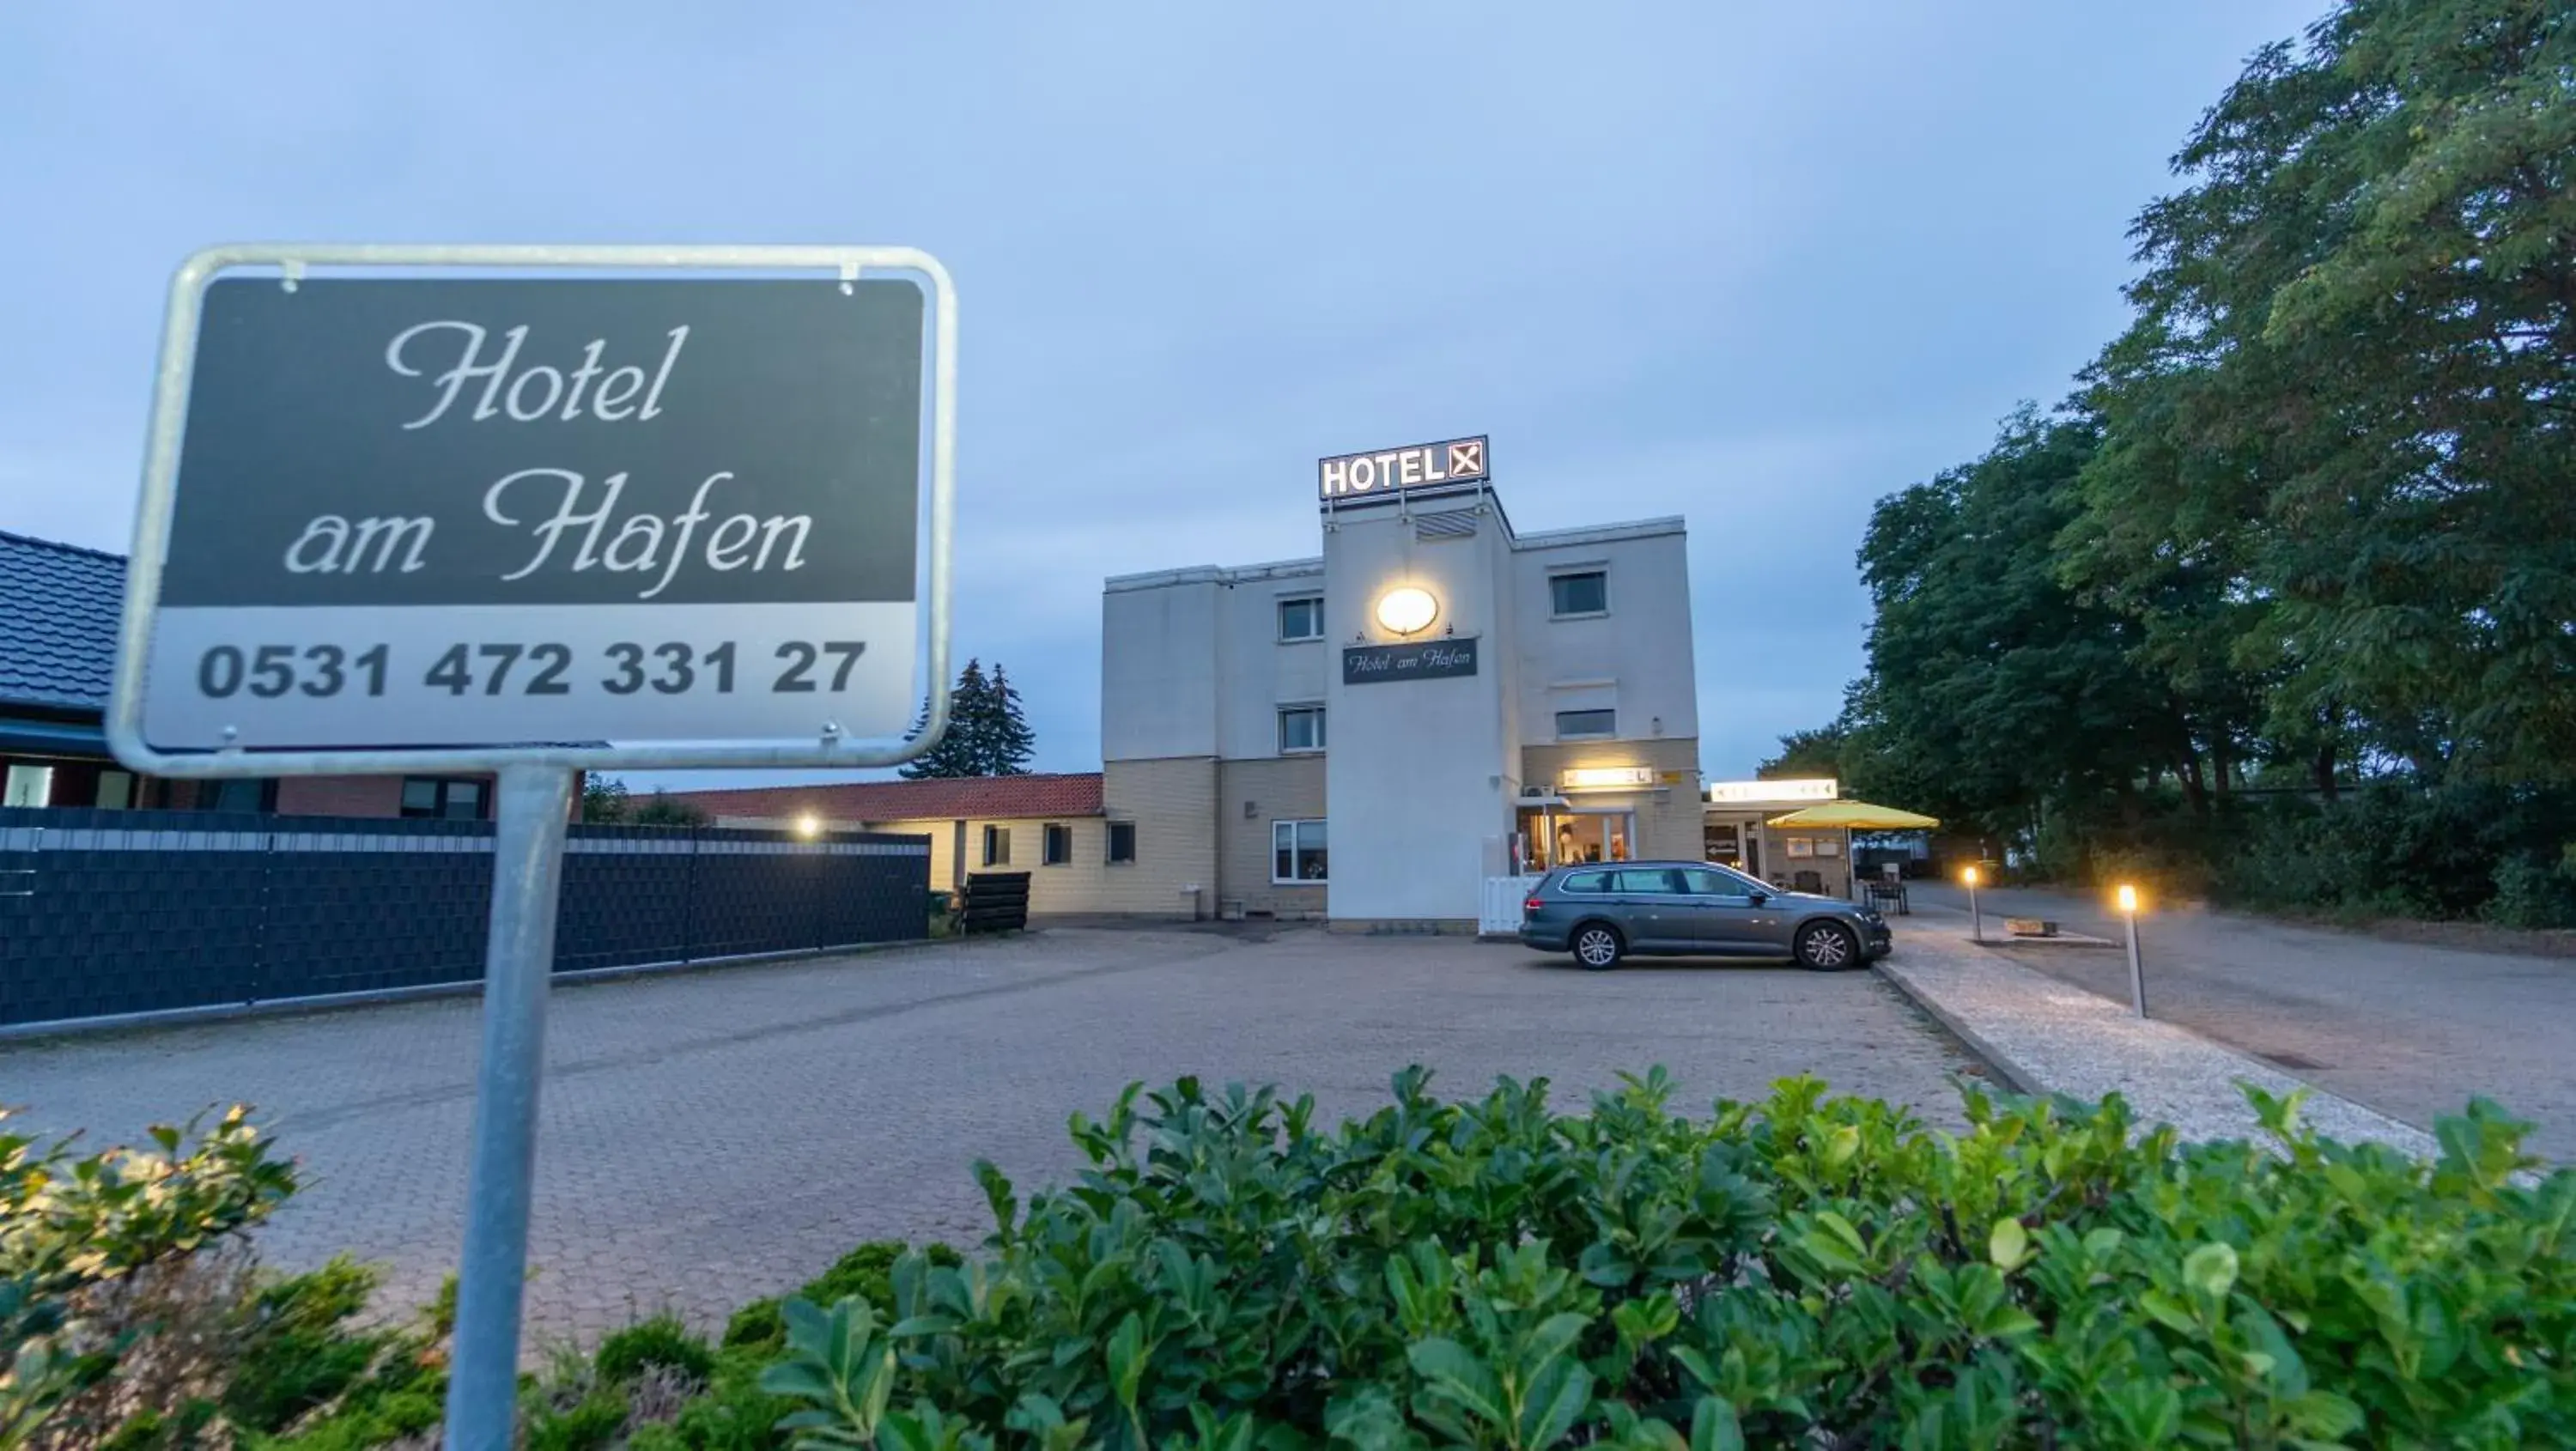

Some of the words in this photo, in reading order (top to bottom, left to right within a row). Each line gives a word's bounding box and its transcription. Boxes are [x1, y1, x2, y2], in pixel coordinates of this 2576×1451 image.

[386, 320, 690, 430] Hotel
[1323, 448, 1445, 495] HOTEL
[283, 513, 435, 574] am
[482, 467, 811, 599] Hafen
[198, 641, 390, 699] 0531
[425, 641, 574, 698] 472
[601, 640, 735, 695] 331
[772, 640, 866, 694] 27
[1349, 653, 1390, 673] Hotel
[1397, 657, 1419, 669] am
[1423, 648, 1470, 669] Hafen
